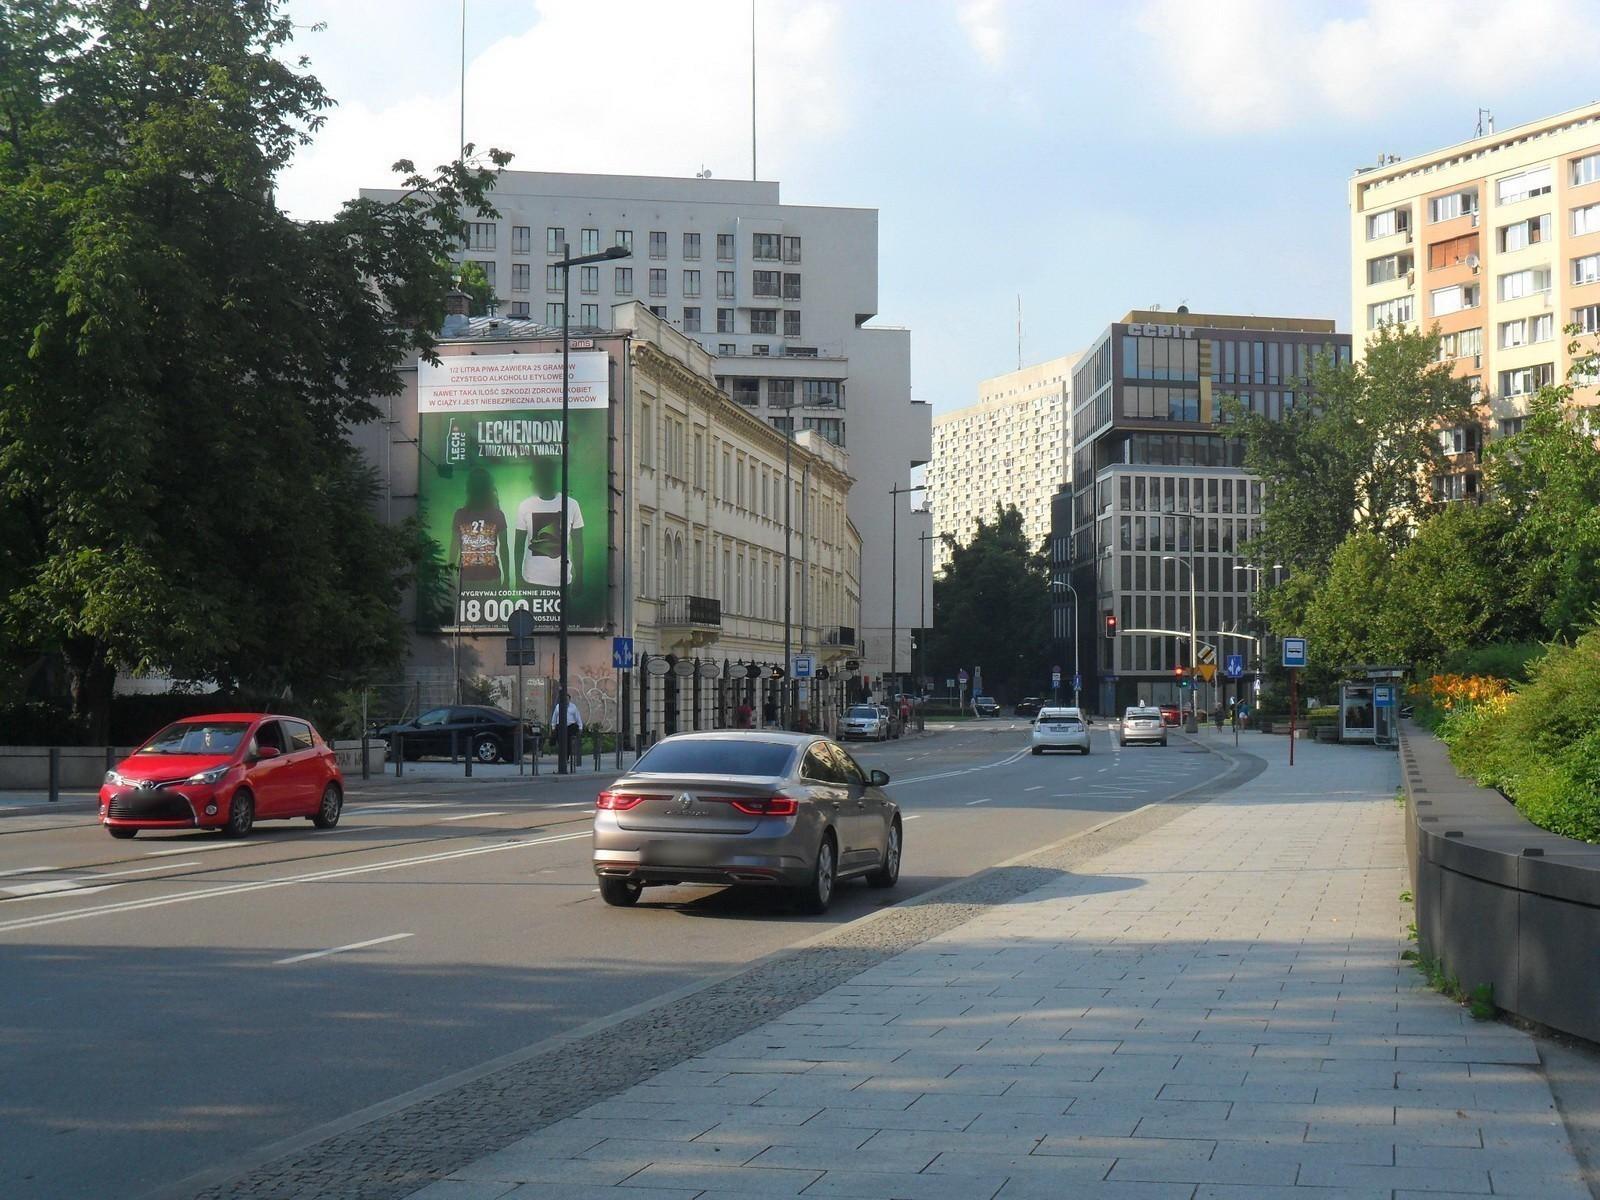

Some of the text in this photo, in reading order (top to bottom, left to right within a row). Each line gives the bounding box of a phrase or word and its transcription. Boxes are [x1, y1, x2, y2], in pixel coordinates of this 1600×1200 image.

[1127, 323, 1195, 339] CCPIT
[543, 363, 576, 371] GRAMW
[451, 432, 460, 460] LECH
[478, 445, 483, 457] Z
[485, 444, 518, 458] MUZYKĄ
[520, 444, 531, 456] DO
[471, 520, 485, 533] 27
[460, 599, 481, 623] 18
